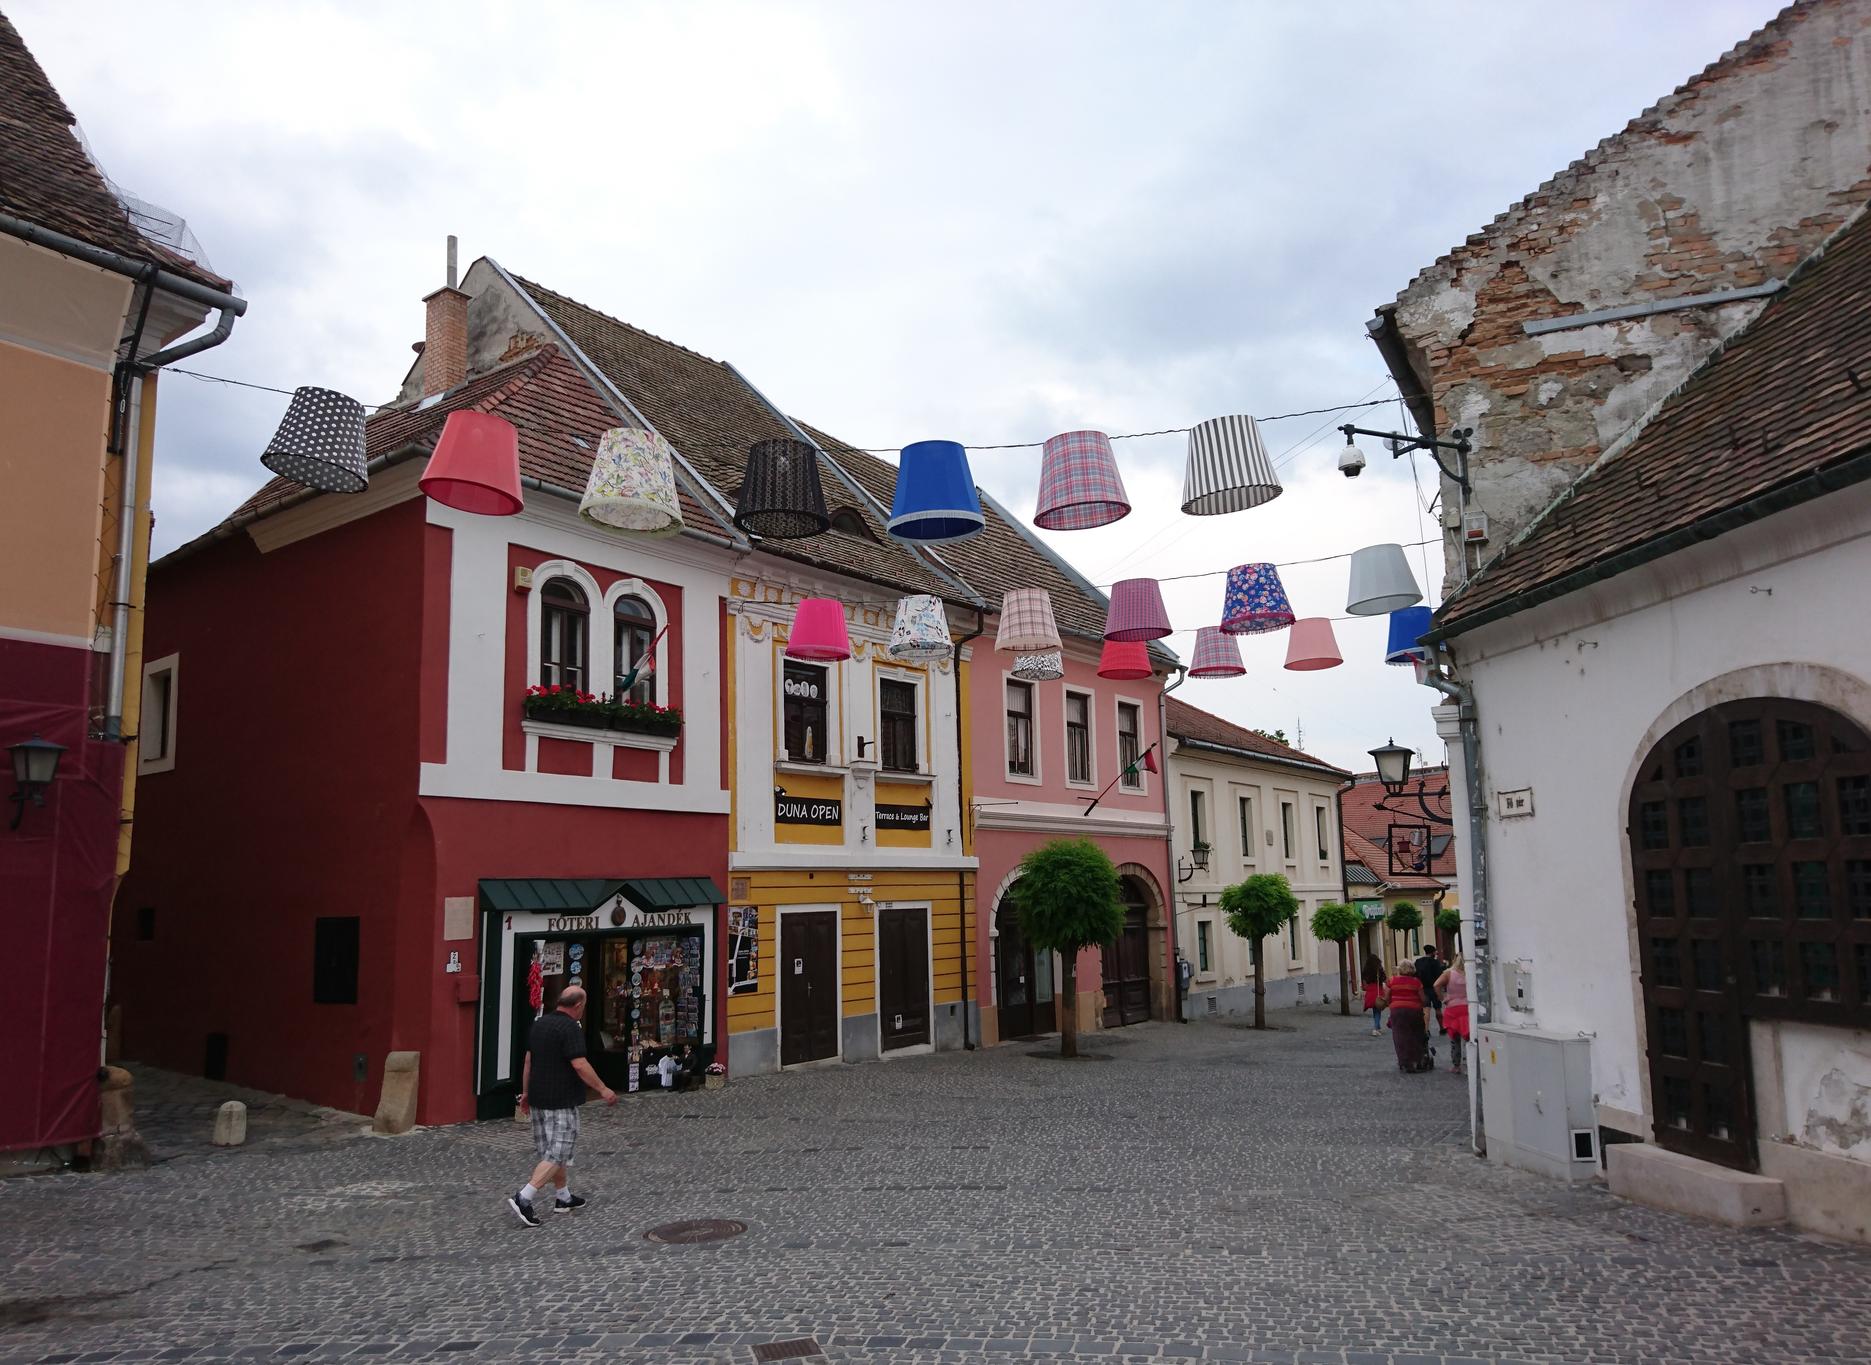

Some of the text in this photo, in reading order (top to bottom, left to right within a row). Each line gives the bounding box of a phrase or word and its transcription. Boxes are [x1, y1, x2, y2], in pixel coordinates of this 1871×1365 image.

[778, 803, 839, 820] DUNA OPEN
[875, 811, 894, 820] Terrace
[900, 812, 918, 824] Lounge
[919, 813, 929, 821] Bar
[505, 915, 513, 931] 1
